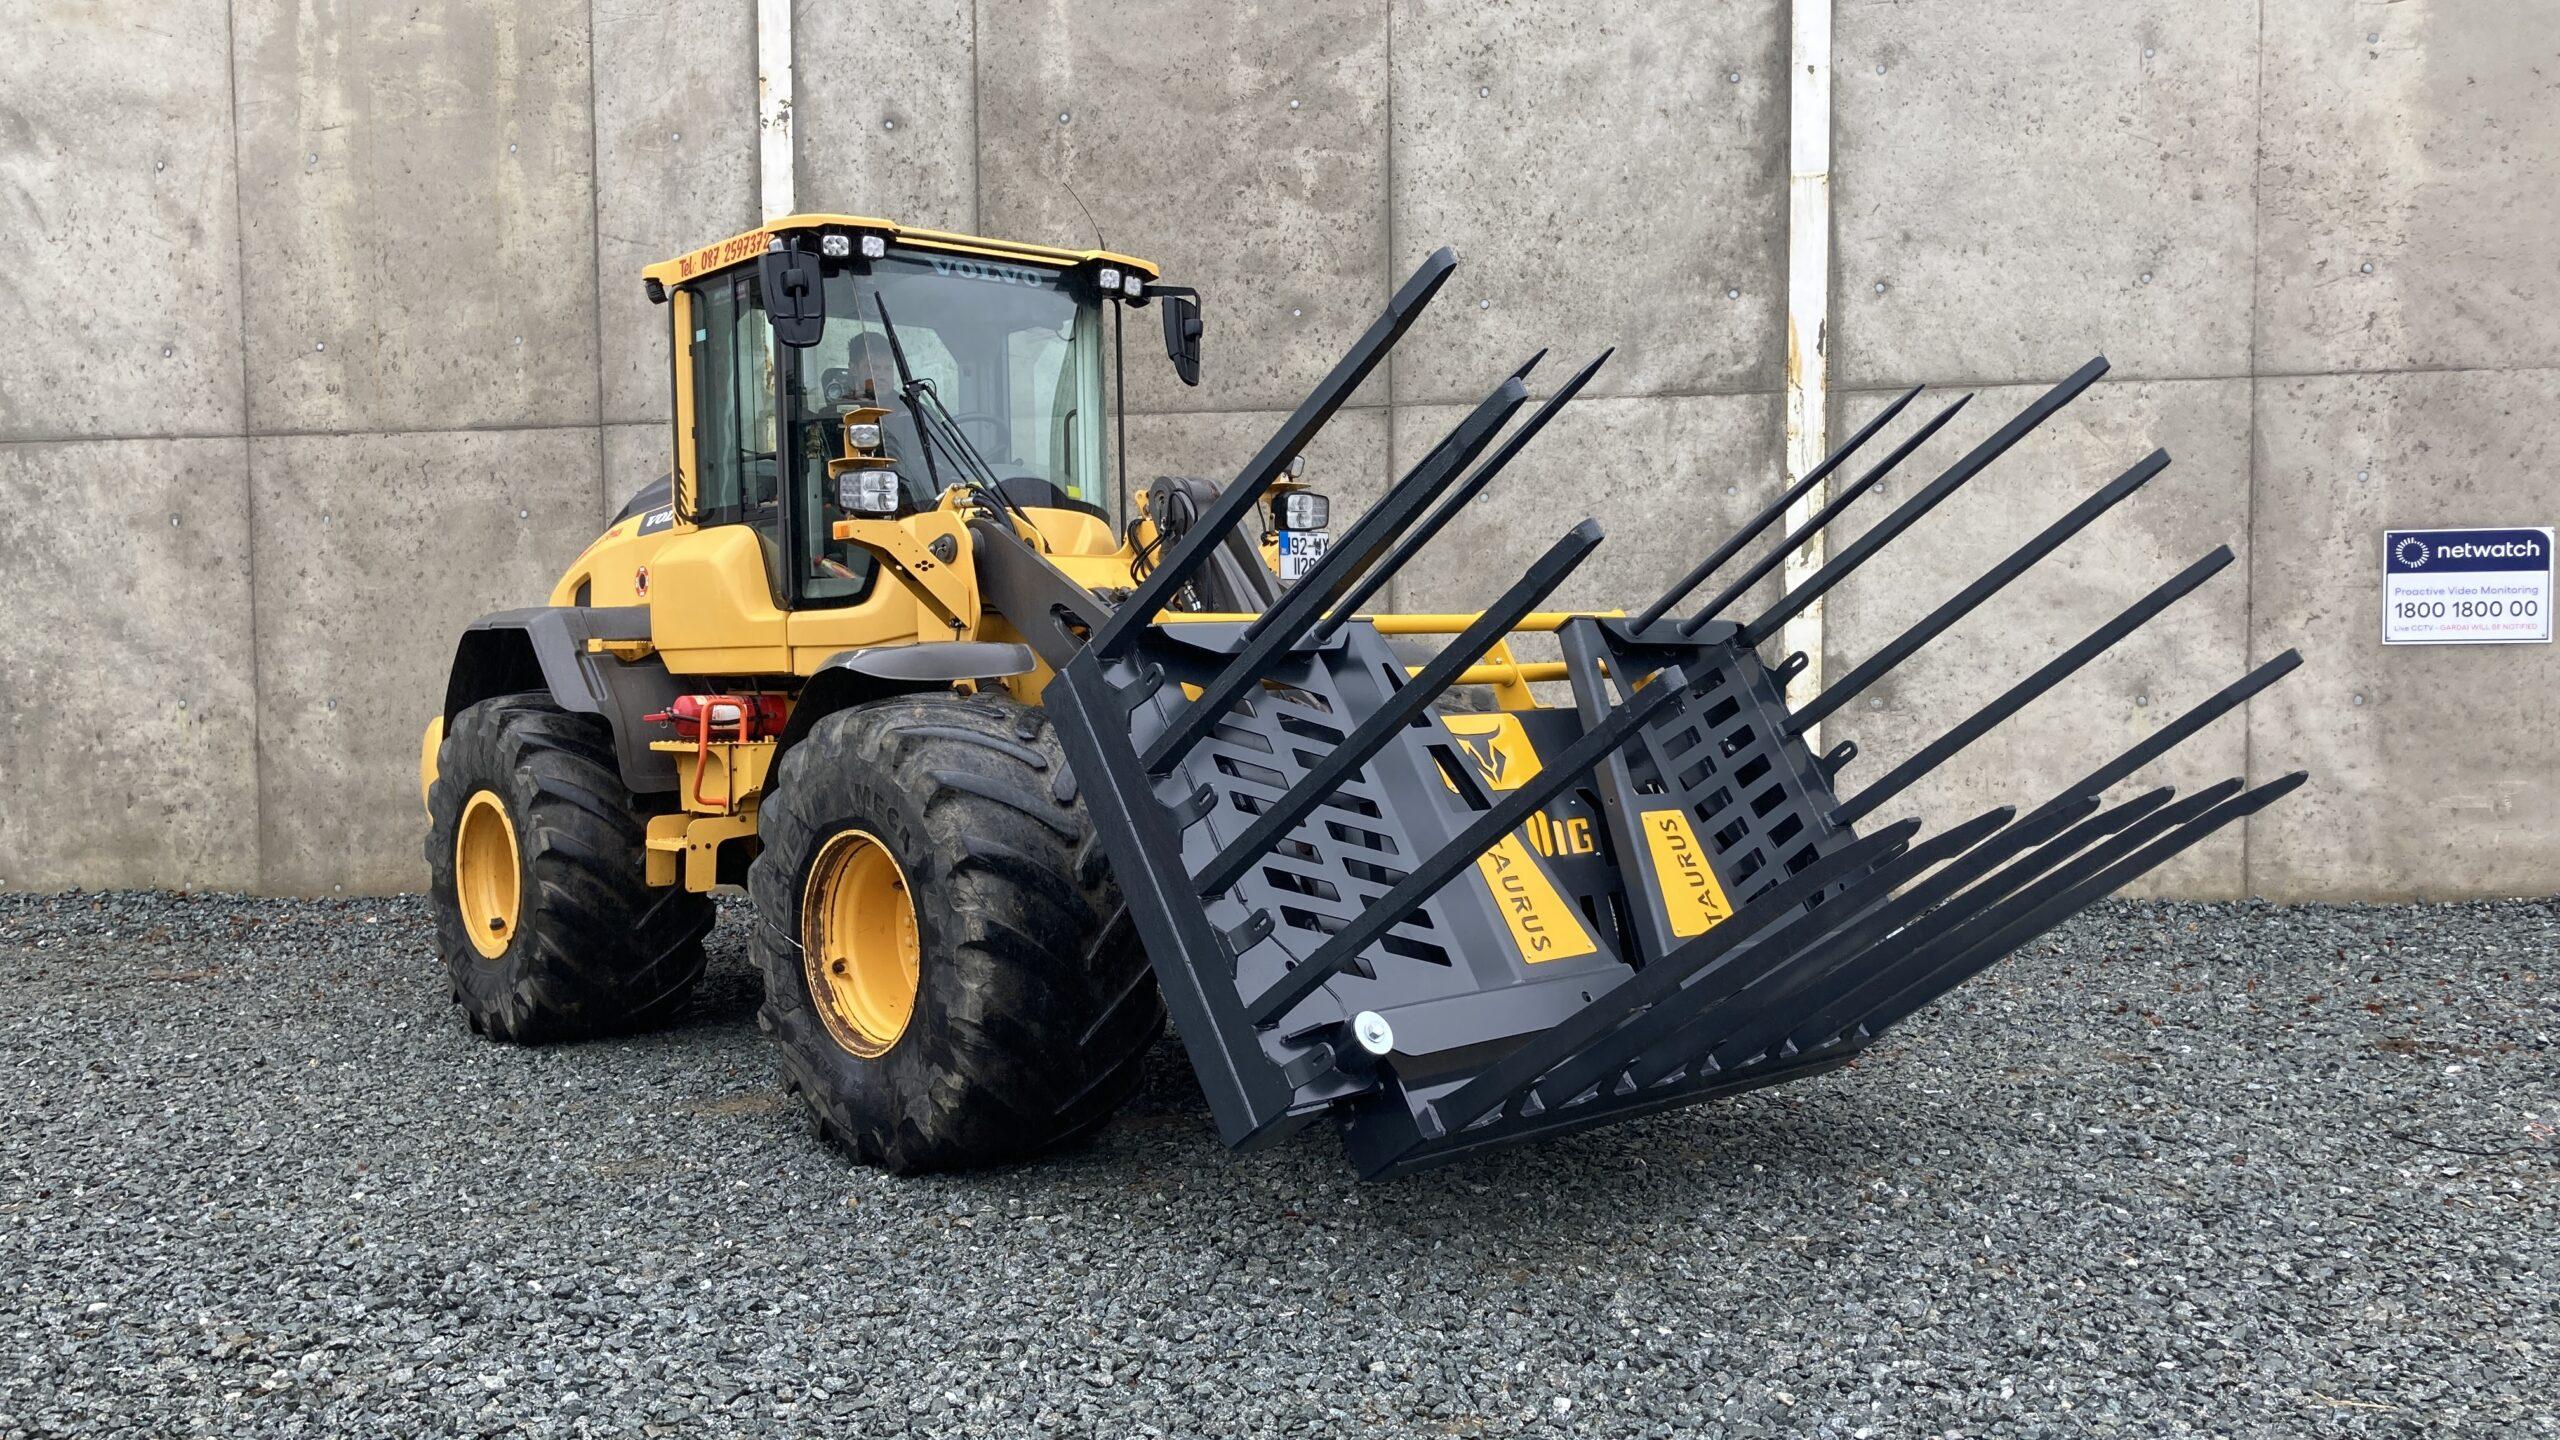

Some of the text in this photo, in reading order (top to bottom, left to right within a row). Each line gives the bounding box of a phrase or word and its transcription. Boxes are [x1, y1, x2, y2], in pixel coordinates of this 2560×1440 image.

[701, 247, 719, 270] 087
[724, 231, 770, 263] 2597372
[925, 257, 1042, 288] VOLVO
[646, 510, 673, 527] VOL
[2437, 540, 2540, 559] netwatch
[2394, 585, 2539, 596] Proactive Video Monitoring
[2395, 600, 2538, 619] 1800 1800 00
[2411, 624, 2433, 632] CCTV
[2471, 623, 2490, 631] WILL
[2503, 622, 2538, 630] NOTIFIED
[1660, 819, 1723, 925] TAURUS
[1488, 842, 1552, 952] AURUS
